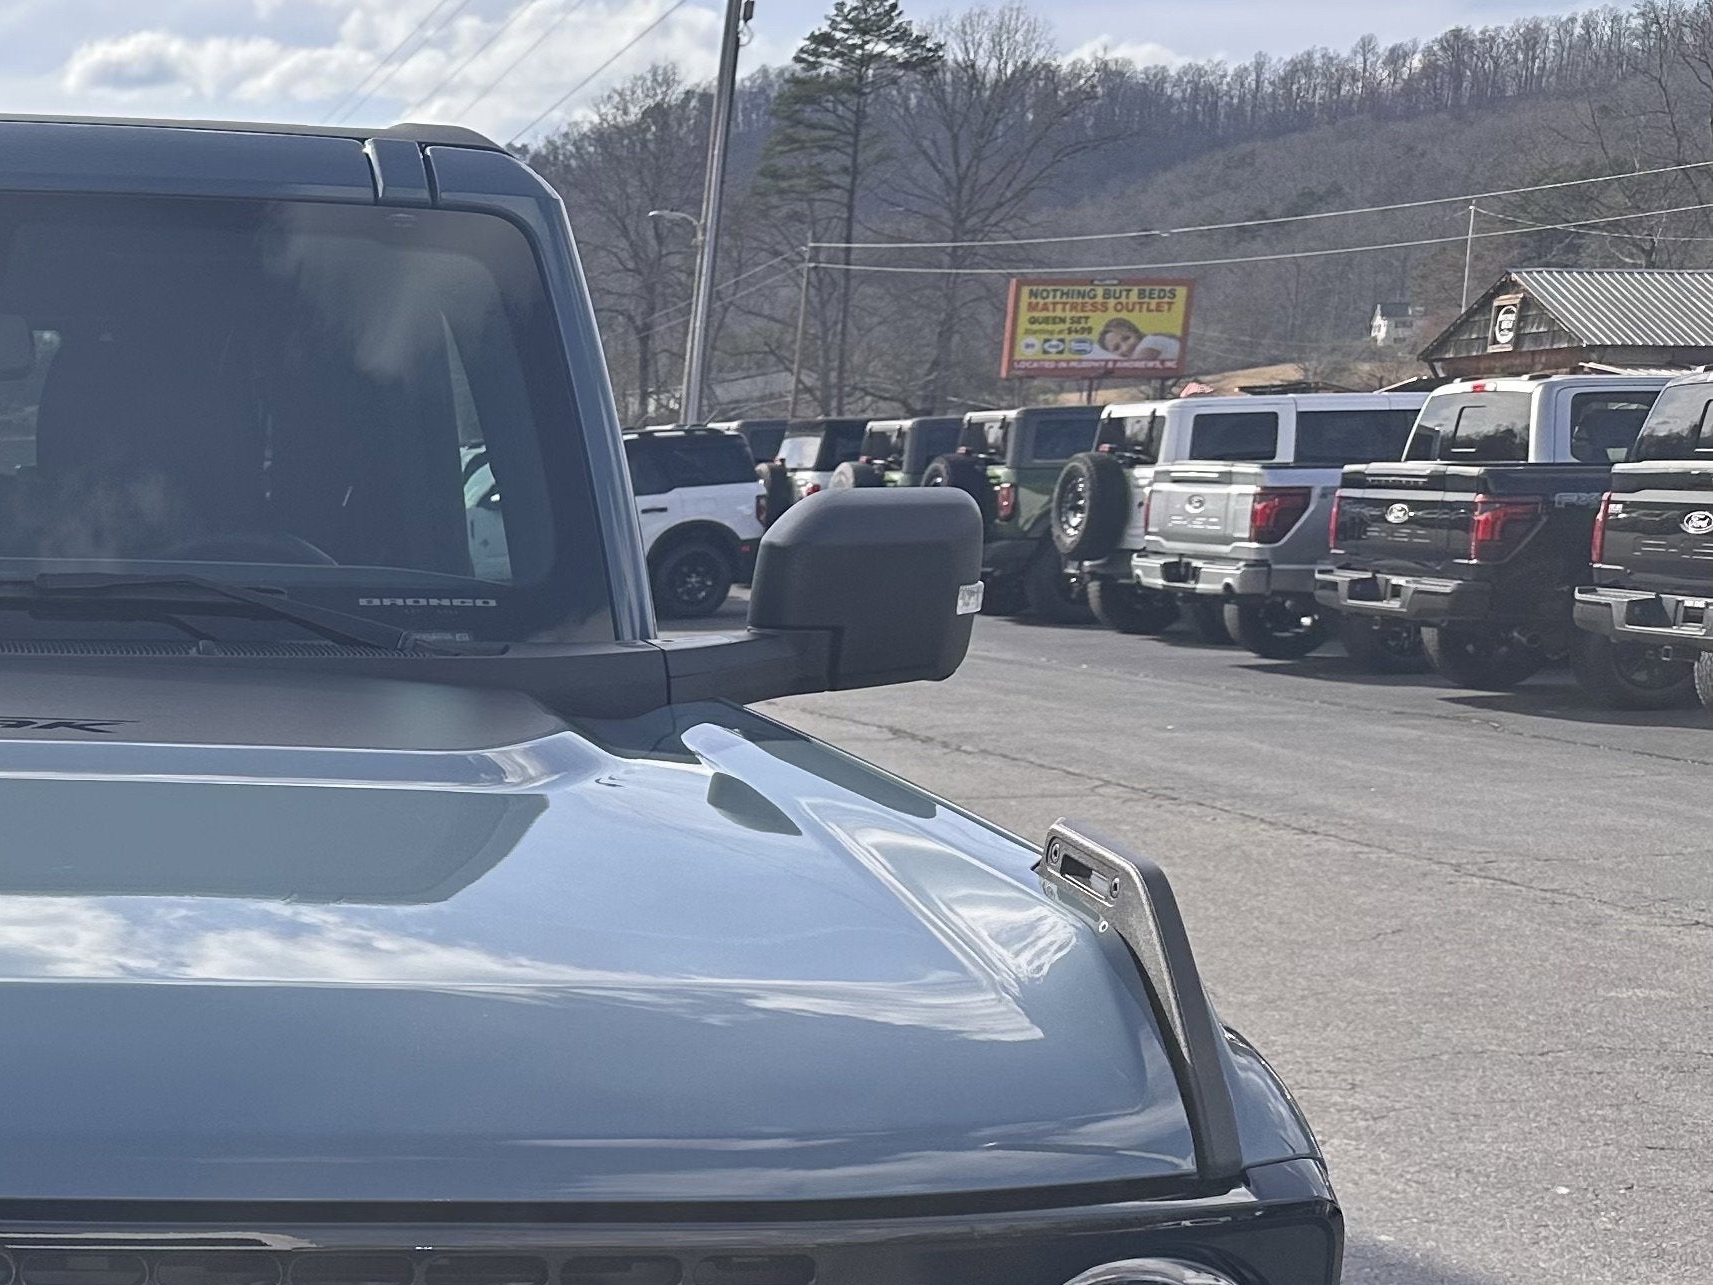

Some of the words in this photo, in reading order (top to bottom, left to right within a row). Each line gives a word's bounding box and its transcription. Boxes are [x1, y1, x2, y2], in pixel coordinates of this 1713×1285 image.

[1029, 288, 1097, 300] NOTHING
[1102, 288, 1133, 300] BUT
[1137, 288, 1177, 300] BEDS
[1027, 301, 1109, 313] MATTRESS
[1113, 301, 1175, 313] OUTLET
[1028, 316, 1067, 325] QUEEN
[1069, 316, 1090, 325] SET
[359, 598, 497, 606] BRONCO
